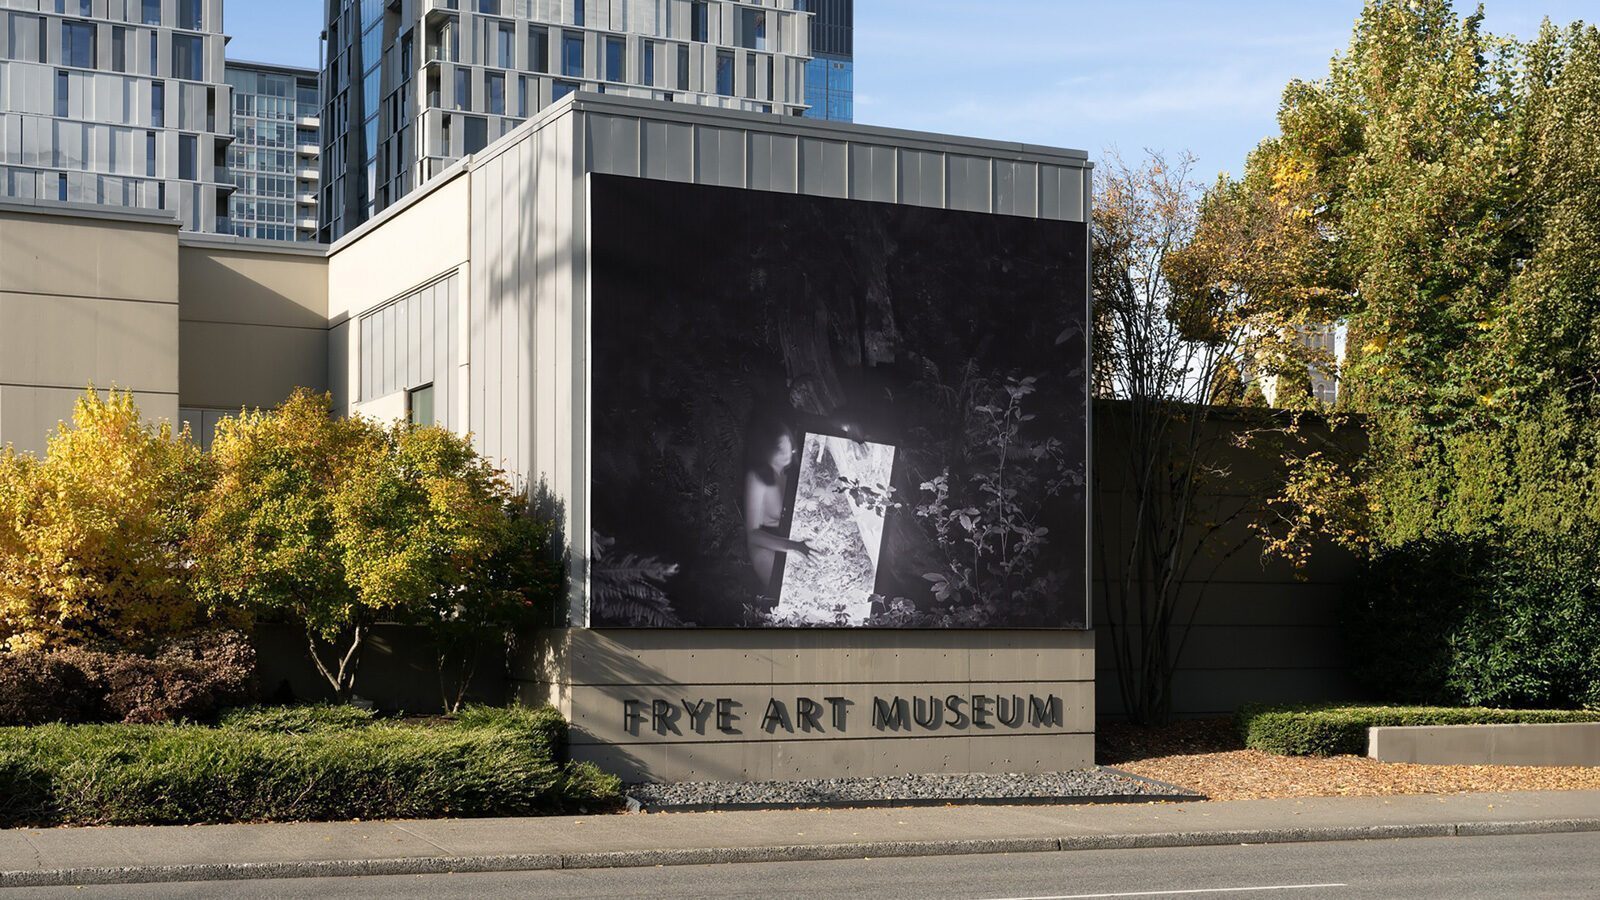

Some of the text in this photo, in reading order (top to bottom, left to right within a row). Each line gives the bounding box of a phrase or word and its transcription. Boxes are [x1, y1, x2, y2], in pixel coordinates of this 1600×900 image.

[623, 693, 1058, 733] FRYE ART MUSEUM
